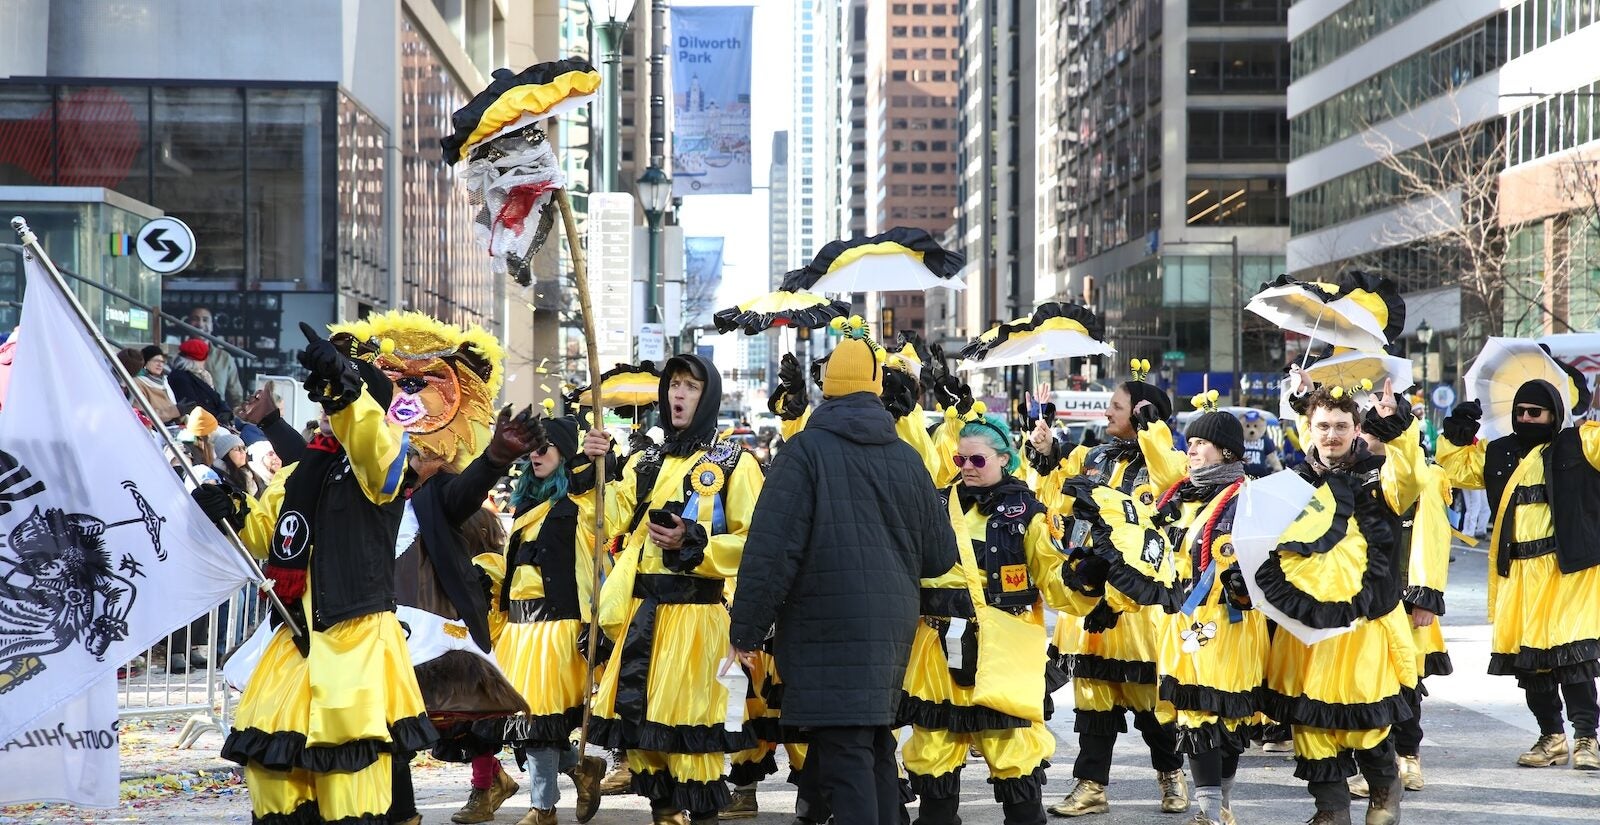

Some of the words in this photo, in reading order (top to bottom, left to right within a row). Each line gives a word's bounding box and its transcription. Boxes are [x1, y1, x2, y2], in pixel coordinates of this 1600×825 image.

[678, 36, 741, 49] Dilworth
[678, 51, 712, 63] Park
[1065, 400, 1108, 410] U-HA
